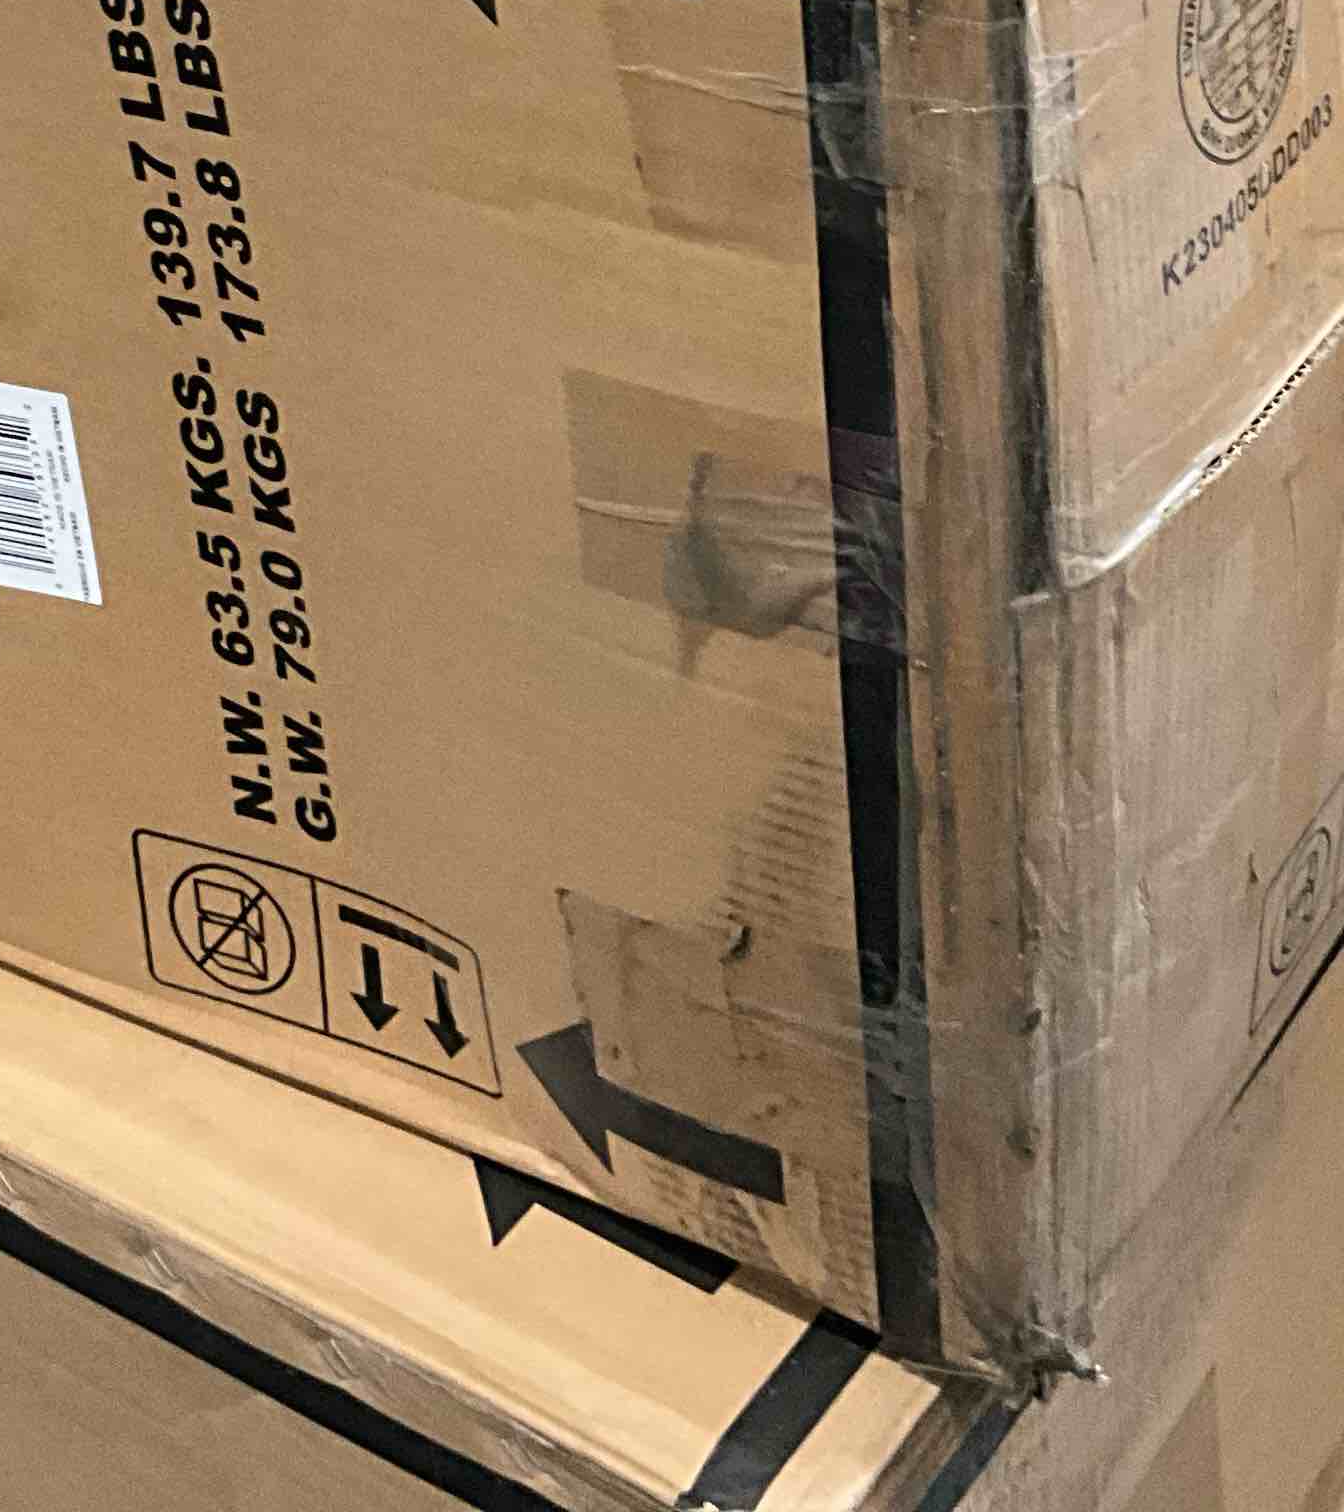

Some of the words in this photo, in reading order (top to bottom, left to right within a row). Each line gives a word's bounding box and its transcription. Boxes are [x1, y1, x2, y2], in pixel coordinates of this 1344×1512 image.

[127, 140, 203, 327] 139.7
[194, 157, 267, 344] 173.8
[171, 354, 235, 515] KGS.
[234, 387, 299, 535] KGS
[194, 529, 256, 668] 63.5
[259, 548, 318, 685] 79.0
[218, 690, 279, 826] N.W.
[282, 709, 339, 844] G.W.
